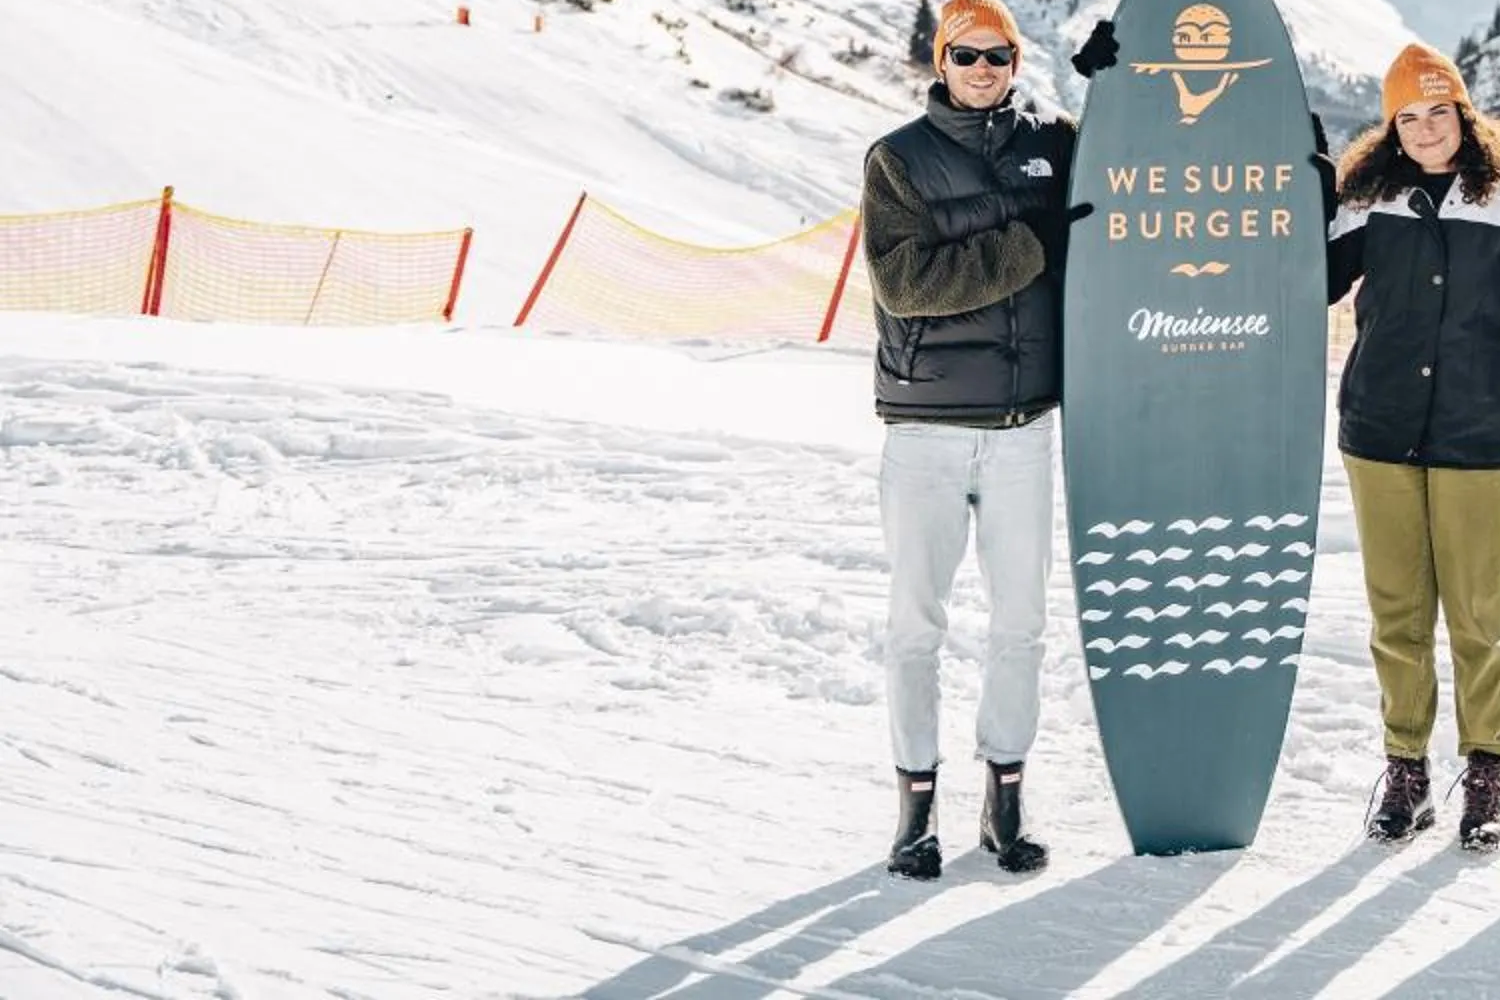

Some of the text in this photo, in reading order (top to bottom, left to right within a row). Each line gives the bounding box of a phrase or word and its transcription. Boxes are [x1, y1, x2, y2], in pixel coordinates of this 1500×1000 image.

[1107, 164, 1293, 195] WE SURF
[1107, 209, 1292, 241] BURGER
[1127, 307, 1271, 341] Maiensee
